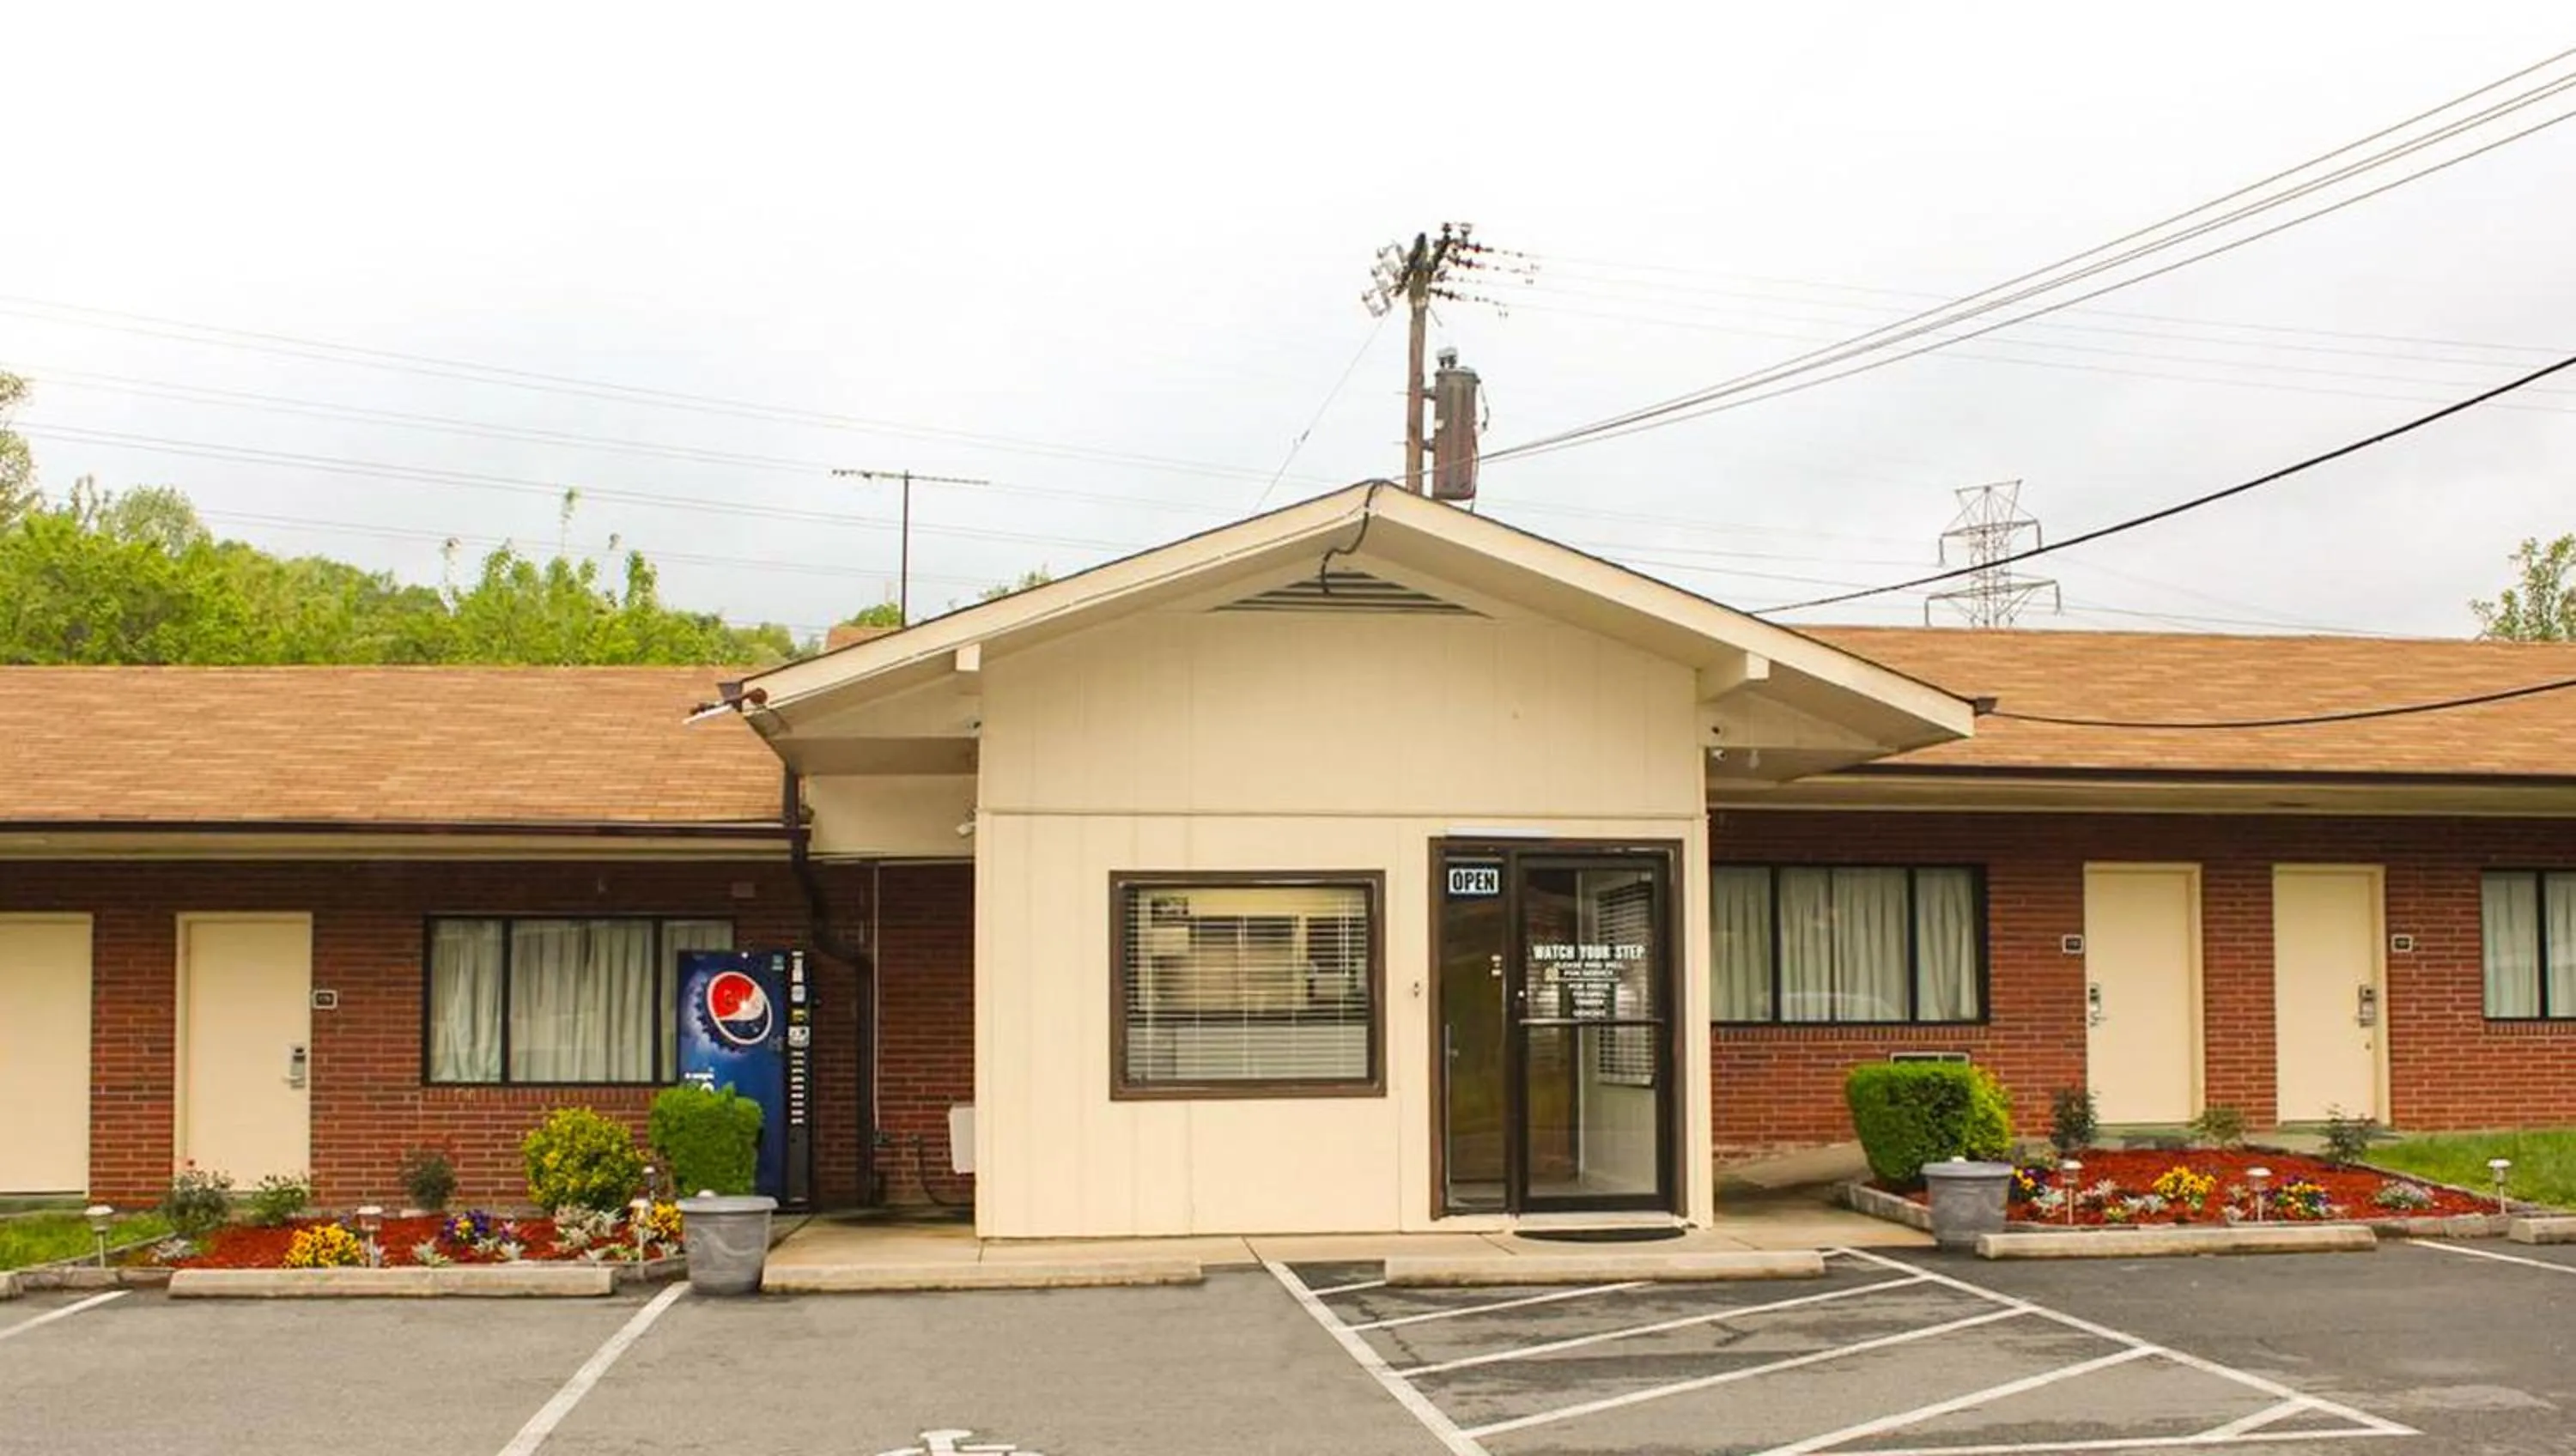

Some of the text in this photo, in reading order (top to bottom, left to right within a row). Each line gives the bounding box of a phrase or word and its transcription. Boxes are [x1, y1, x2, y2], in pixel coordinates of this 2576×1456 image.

[1452, 871, 1495, 890] OPEN
[1532, 944, 1646, 960] WATCH YOUR STEP
